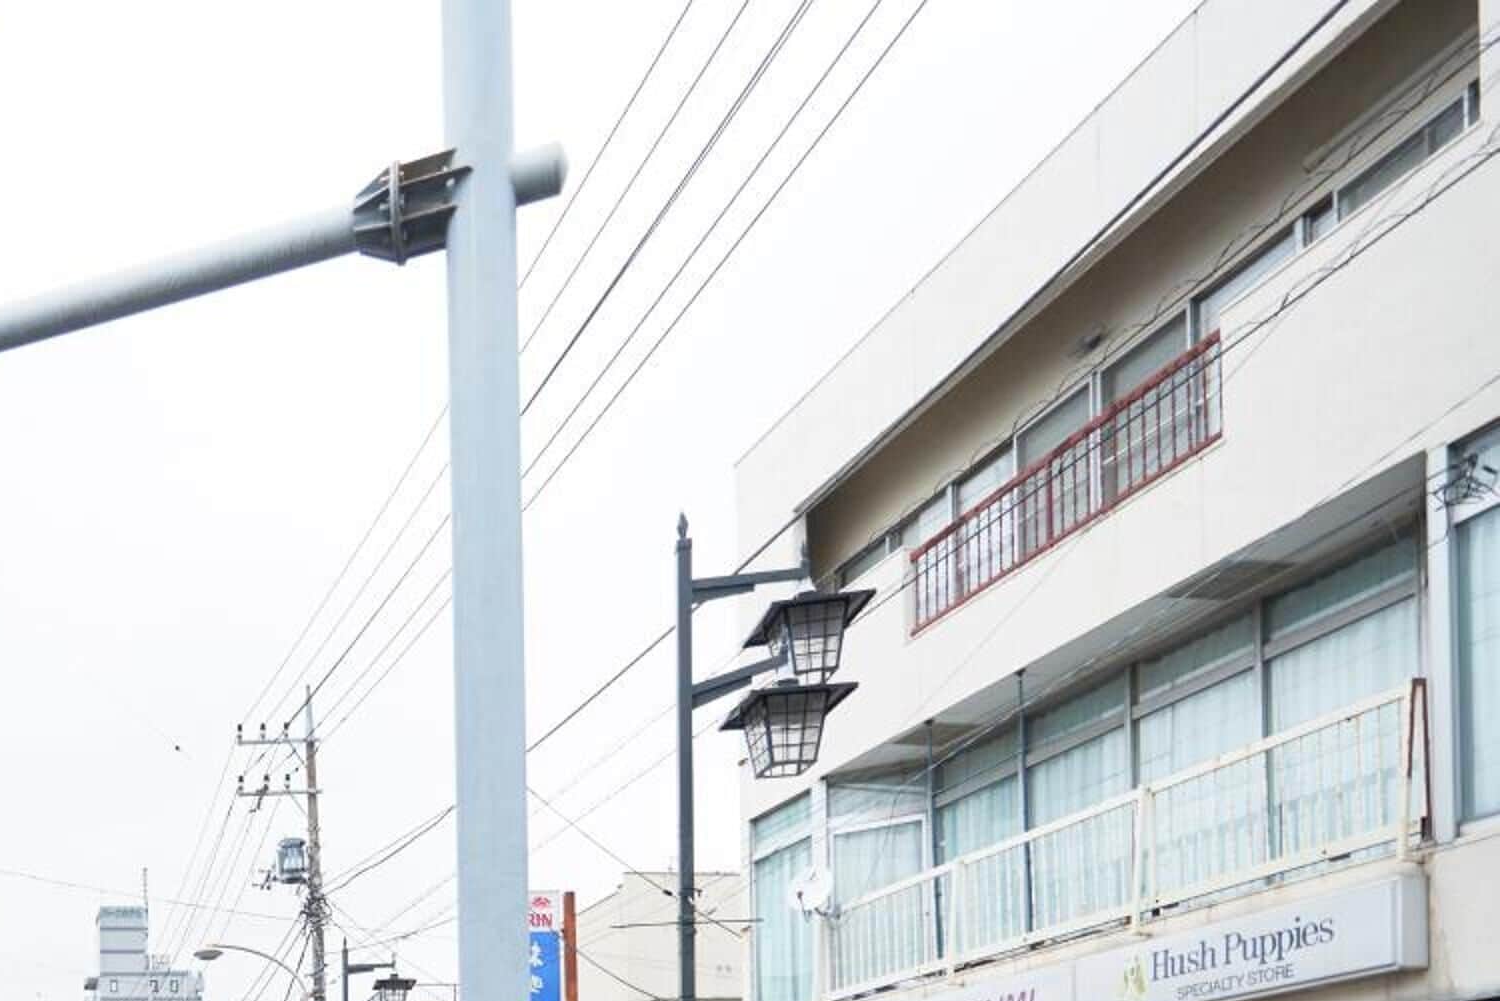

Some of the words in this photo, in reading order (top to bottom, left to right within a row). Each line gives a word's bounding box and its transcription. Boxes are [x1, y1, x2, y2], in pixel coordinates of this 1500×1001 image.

[1151, 938, 1217, 983] Hush
[1223, 916, 1334, 966] Puppies
[1176, 973, 1245, 1001] SPECIALTY
[1249, 962, 1295, 984] STORE
